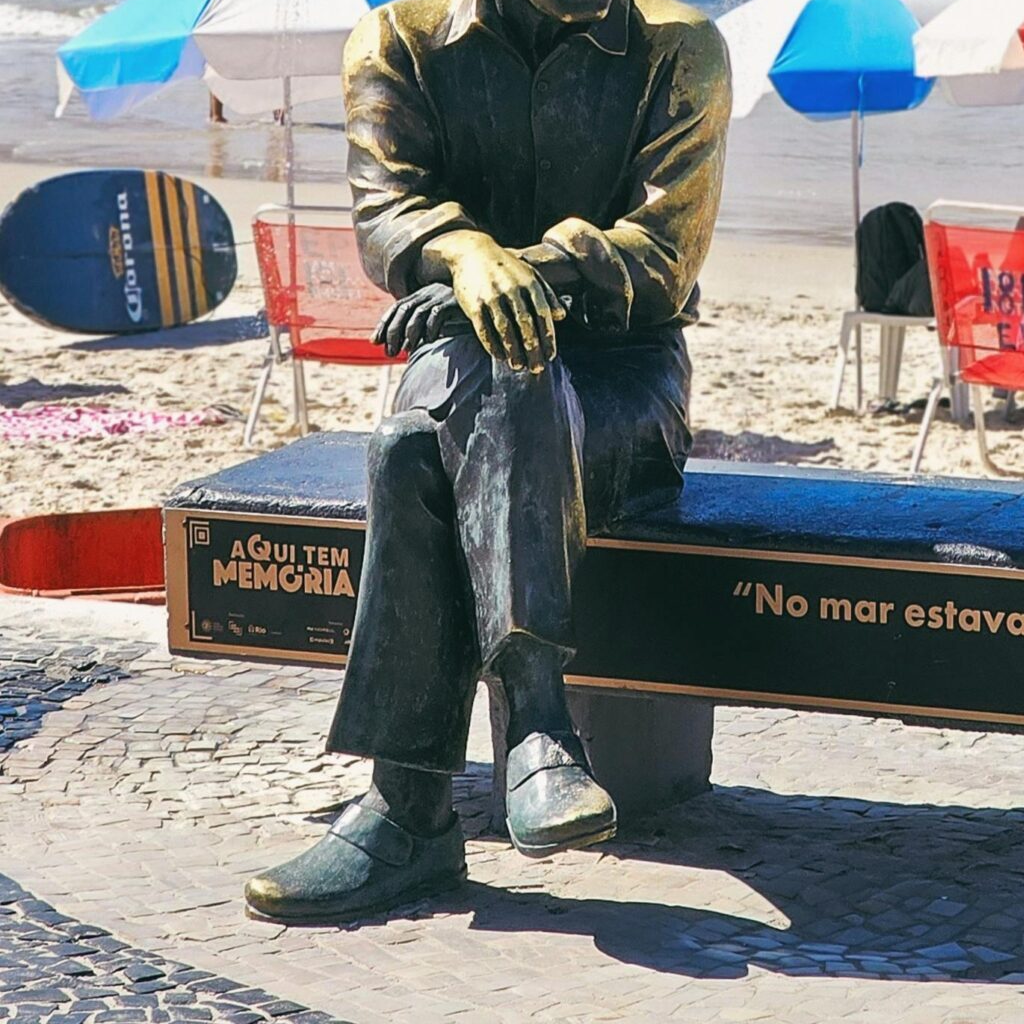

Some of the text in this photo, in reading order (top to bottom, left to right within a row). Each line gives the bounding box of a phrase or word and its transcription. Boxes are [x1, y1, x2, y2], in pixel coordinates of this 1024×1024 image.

[117, 191, 142, 322] Corona
[231, 534, 350, 566] AQUI TEM
[213, 559, 355, 597] MEMÓRIA
[820, 597, 894, 624] mar
